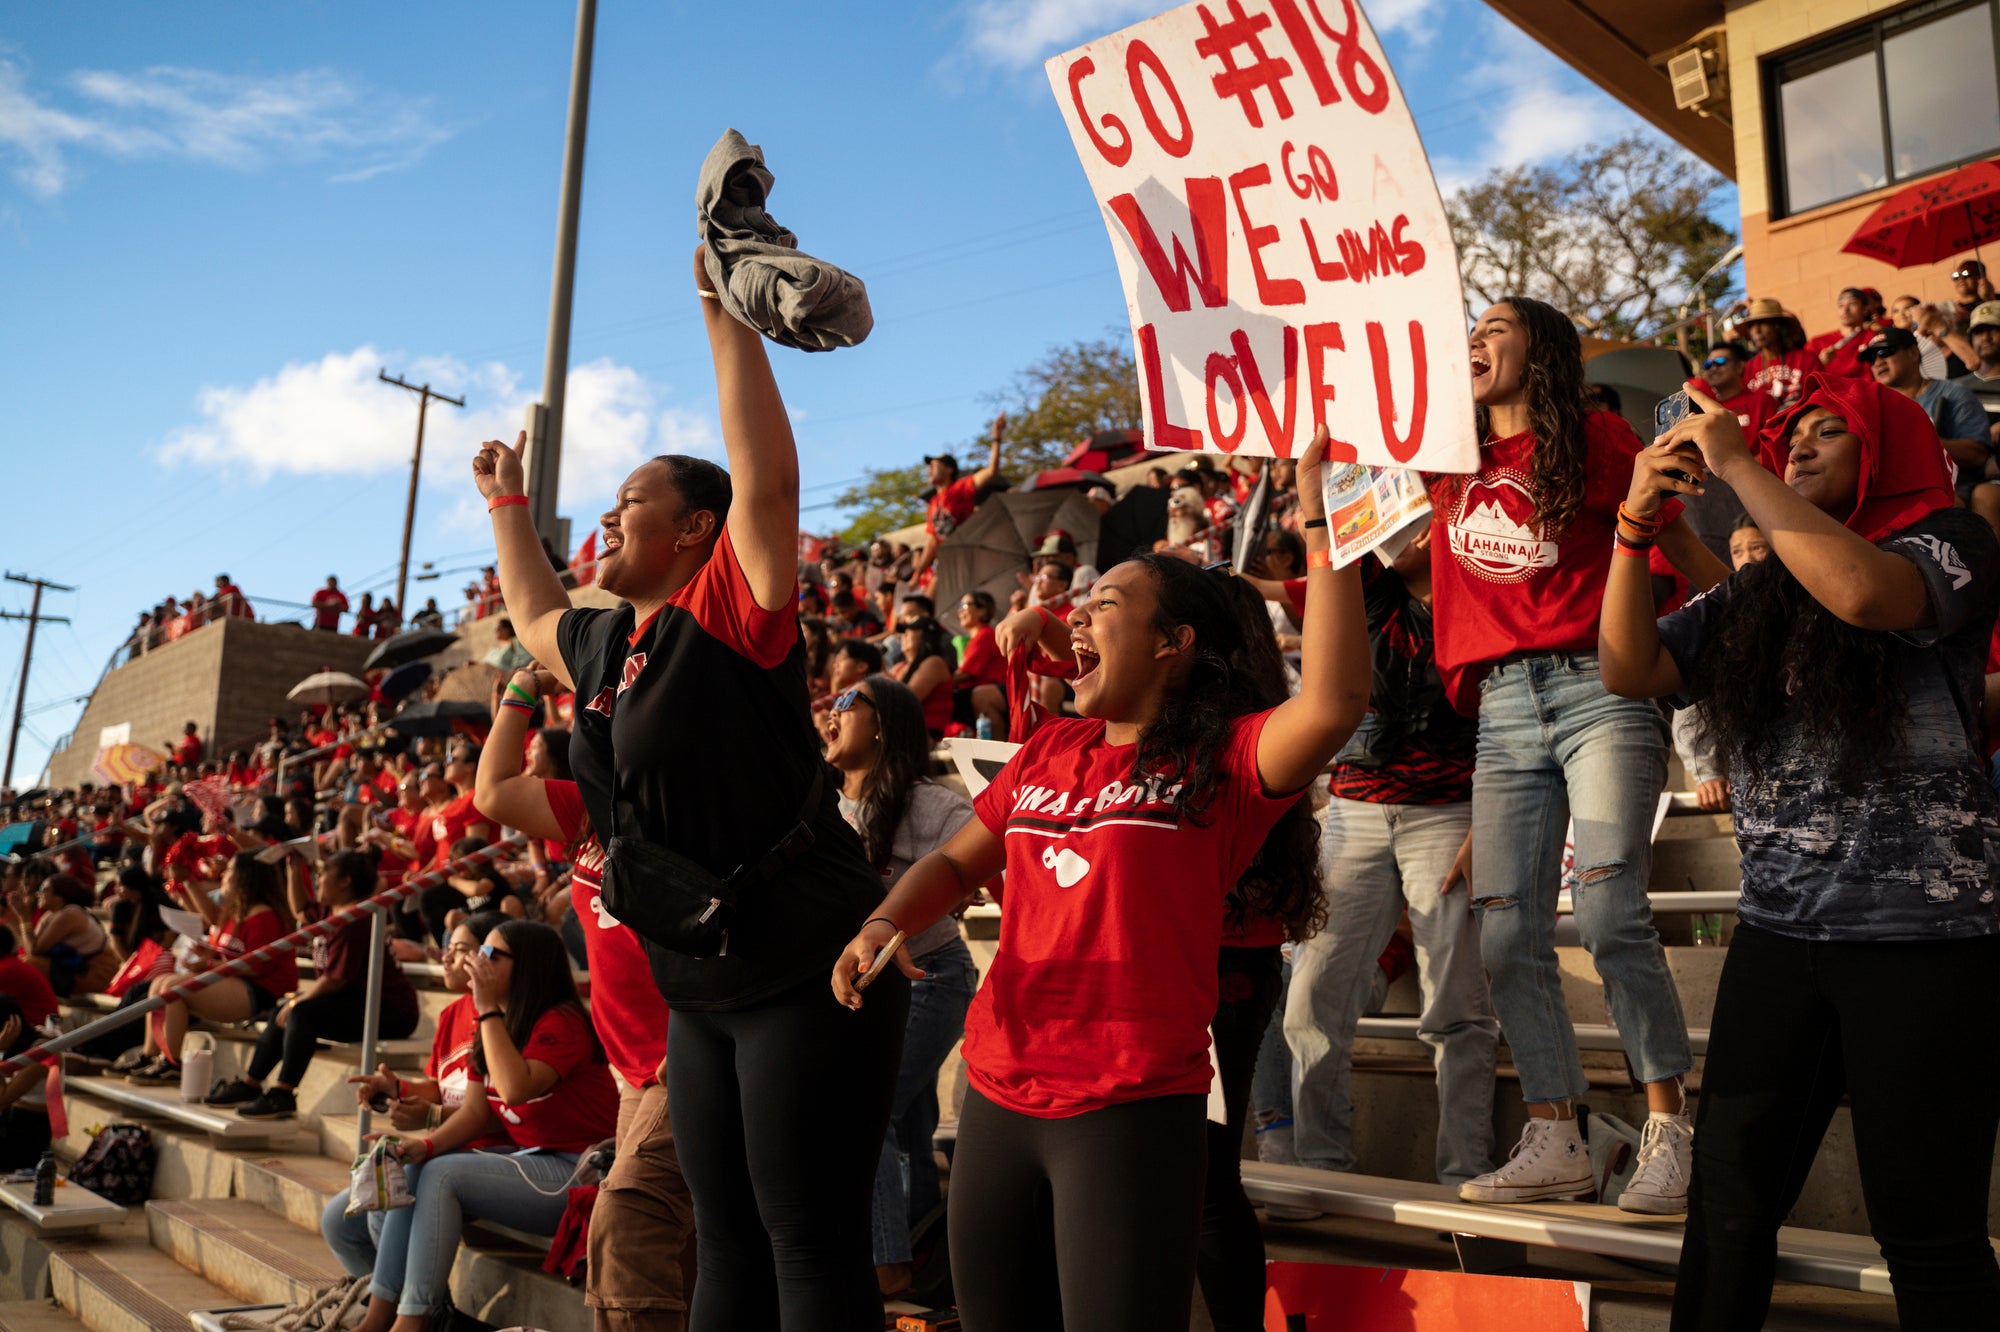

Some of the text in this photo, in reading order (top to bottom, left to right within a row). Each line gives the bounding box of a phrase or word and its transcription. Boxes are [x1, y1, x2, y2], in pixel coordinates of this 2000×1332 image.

[1068, 0, 1390, 167] GO #18
[1281, 140, 1340, 203] GO
[1107, 163, 1306, 312] WE
[1138, 320, 1428, 464] LOVE U
[1464, 532, 1527, 556] LAHAINA
[1480, 550, 1509, 560] STRONG
